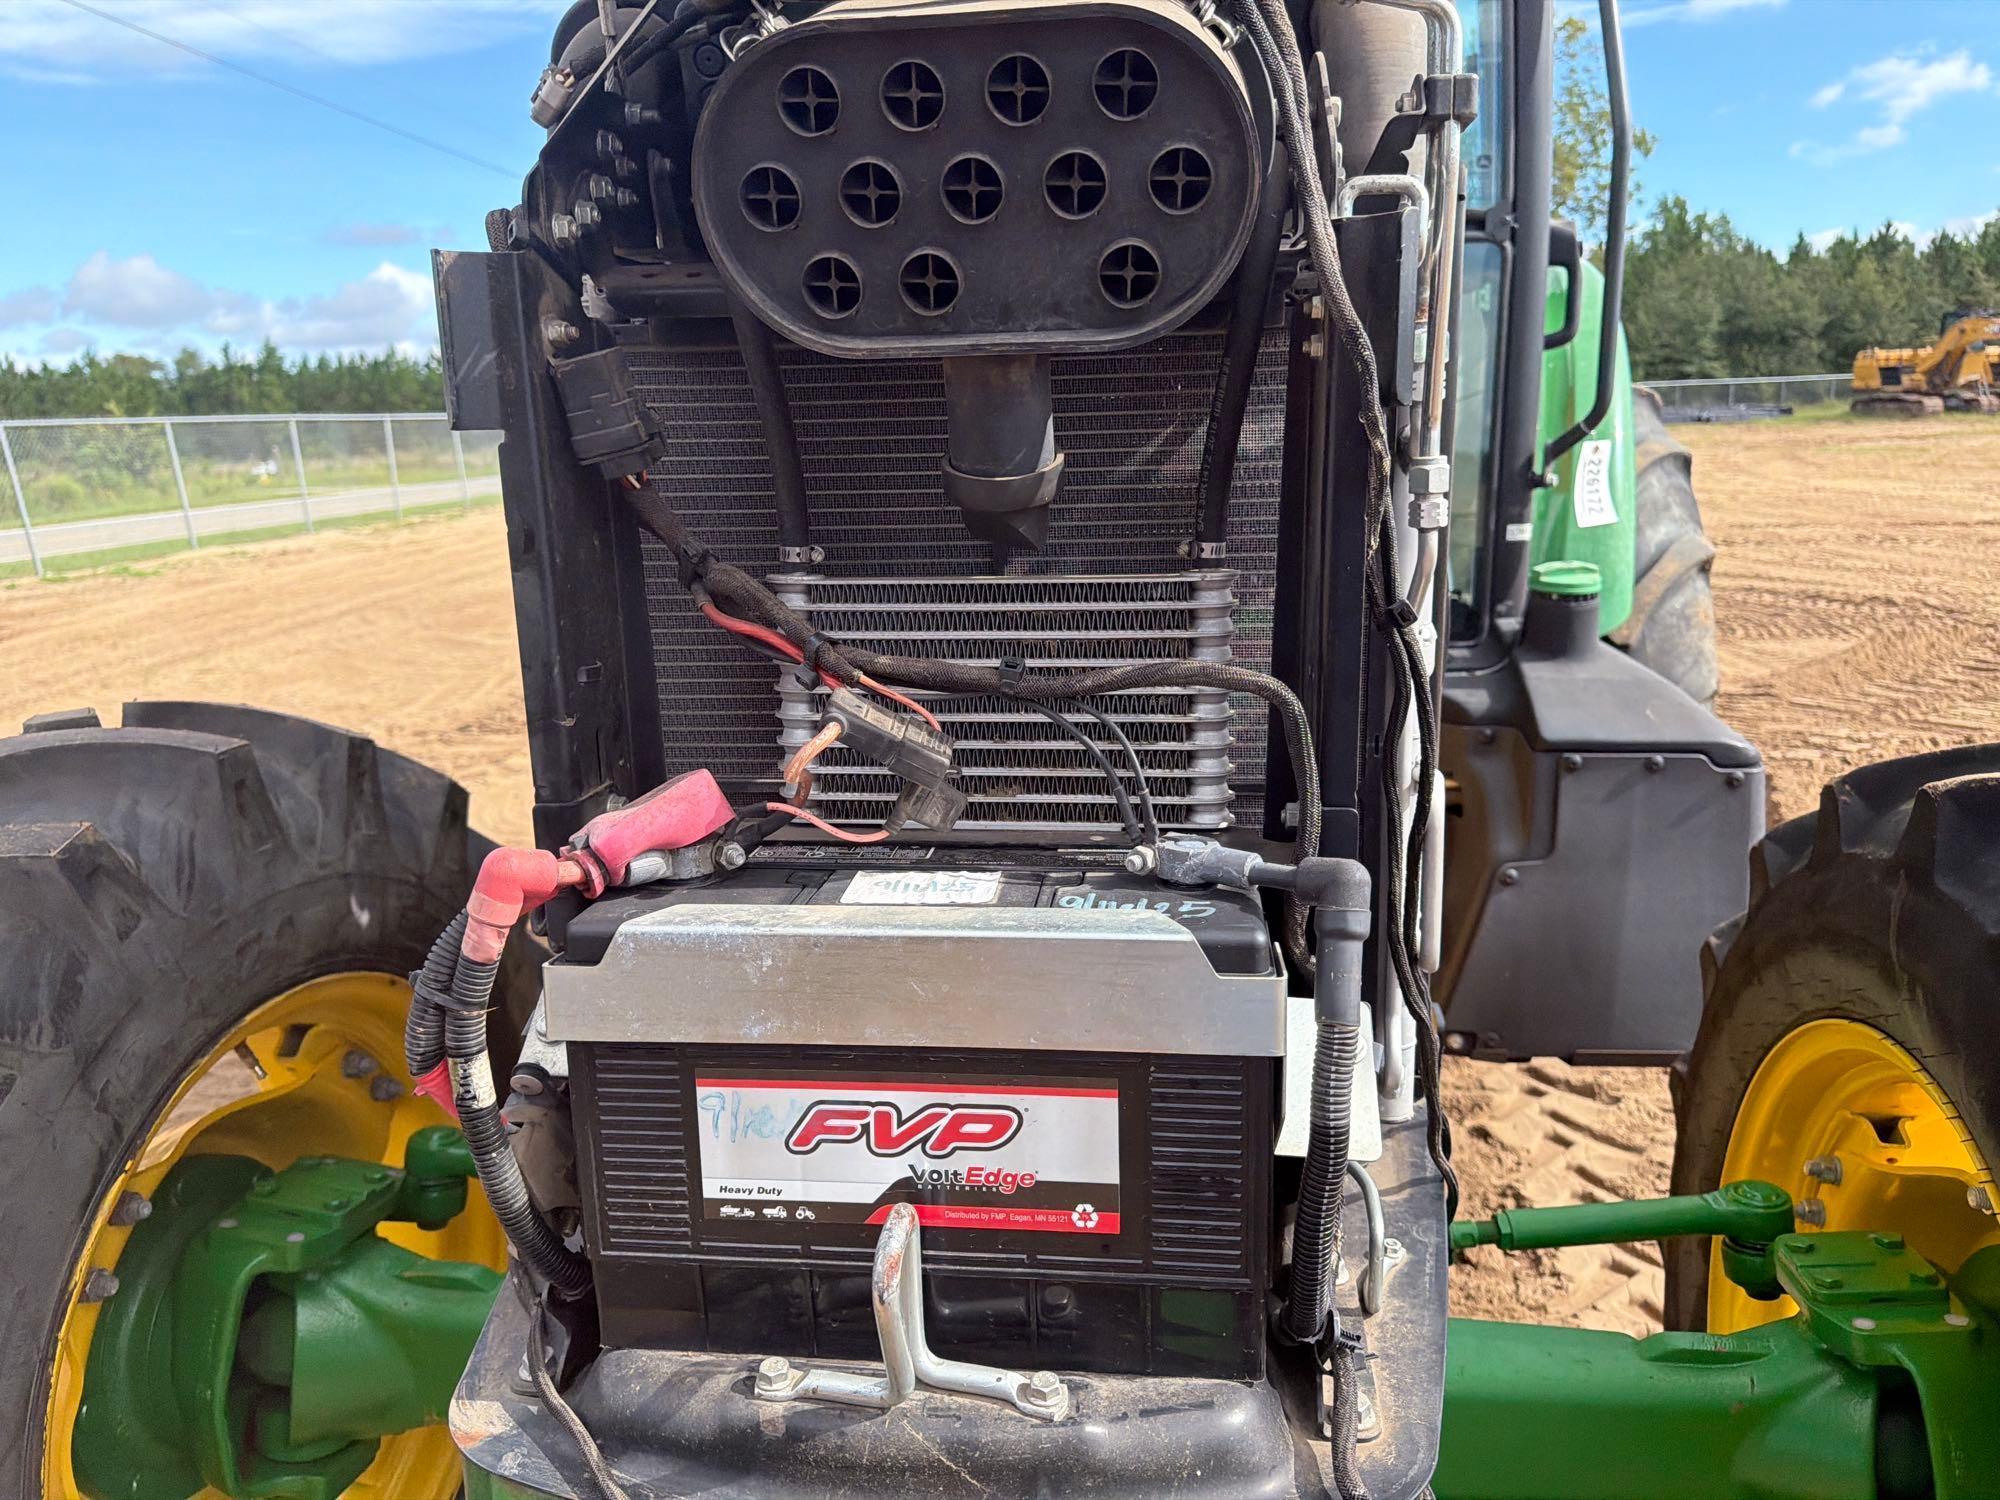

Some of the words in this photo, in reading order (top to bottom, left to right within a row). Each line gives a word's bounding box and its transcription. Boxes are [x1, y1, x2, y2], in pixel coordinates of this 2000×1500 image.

[786, 1101, 1023, 1158] FVP
[908, 1164, 1035, 1194] VoltEdge
[719, 1185, 754, 1196] Heavy
[757, 1186, 783, 1197] Duty
[918, 1184, 997, 1192] BATTERIES
[944, 1210, 980, 1219] Distributed
[981, 1211, 989, 1221] by
[1035, 1214, 1047, 1222] MN
[1048, 1214, 1068, 1223] 55121
